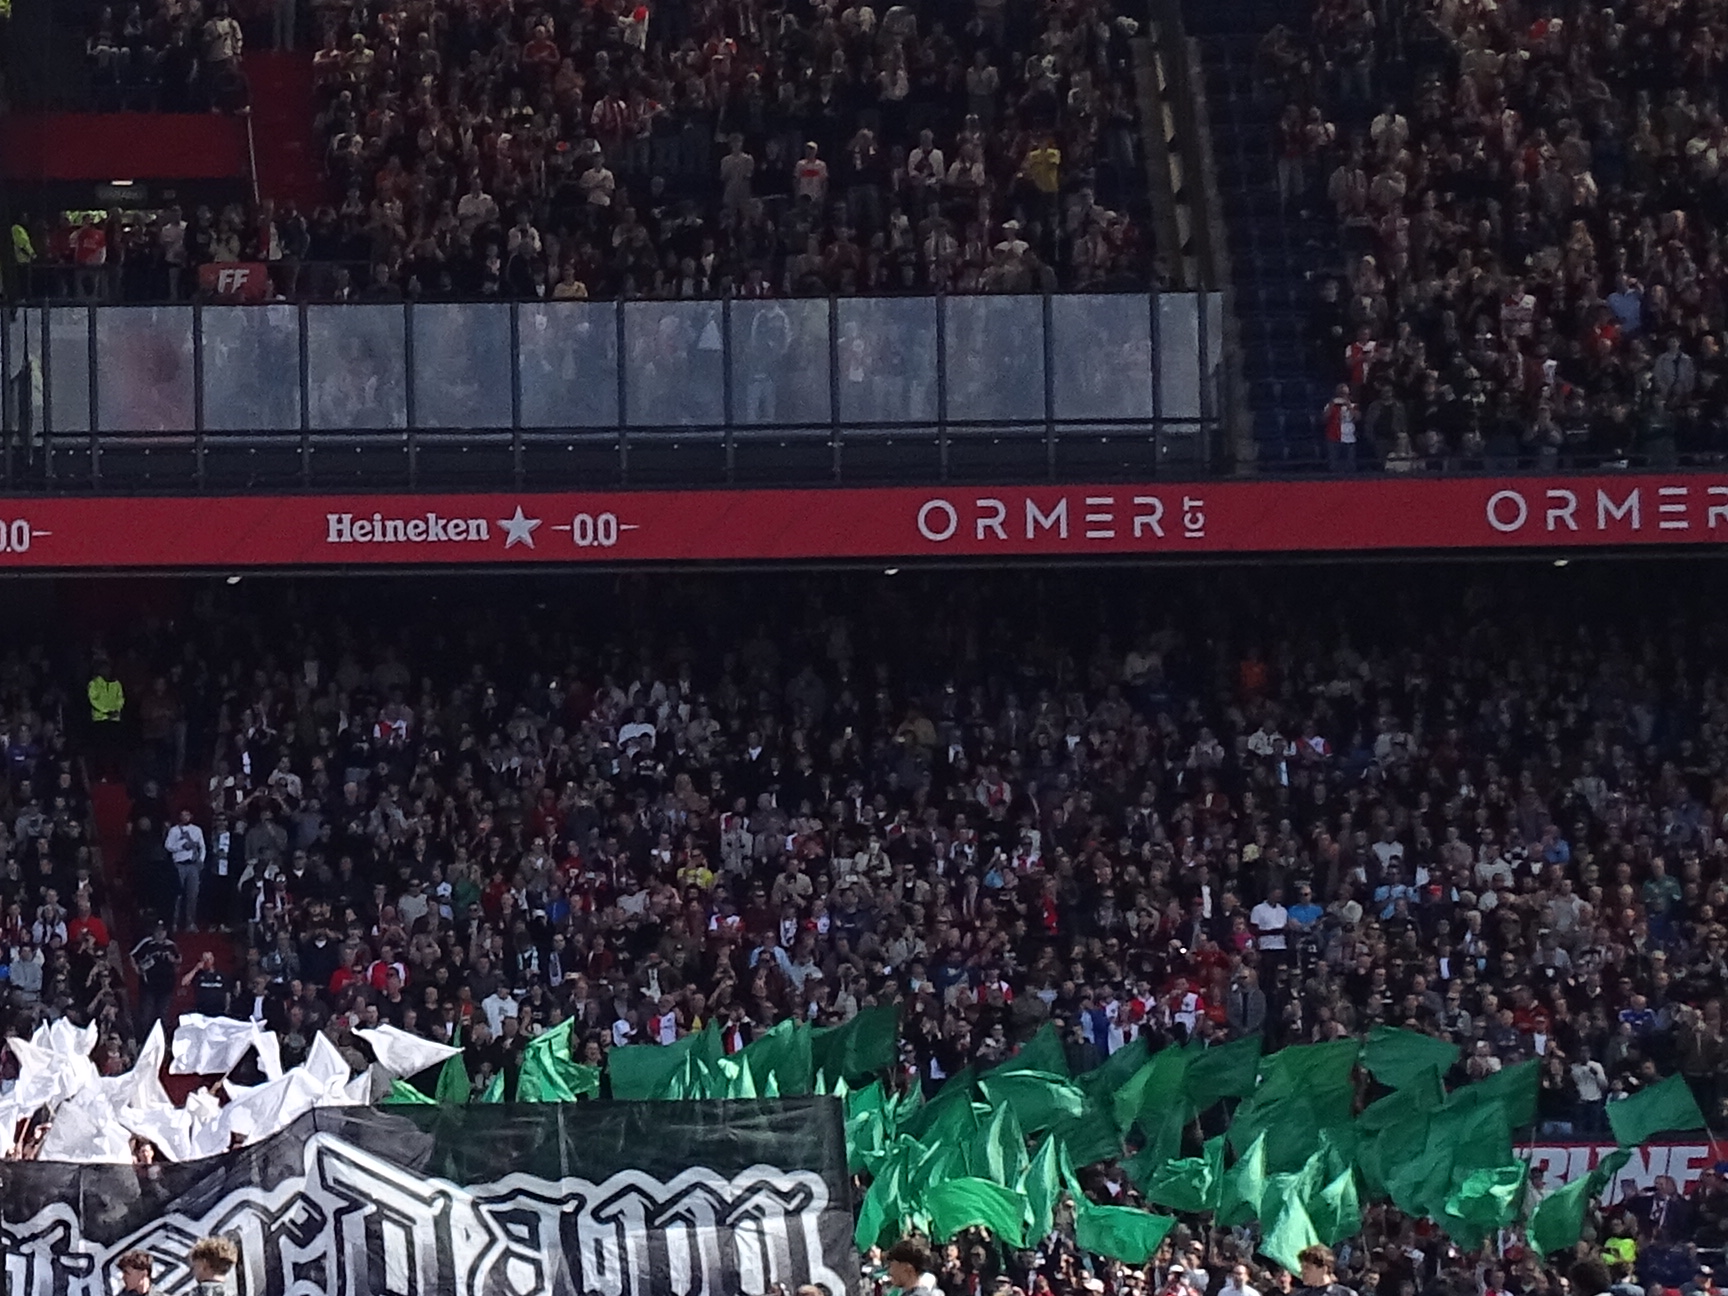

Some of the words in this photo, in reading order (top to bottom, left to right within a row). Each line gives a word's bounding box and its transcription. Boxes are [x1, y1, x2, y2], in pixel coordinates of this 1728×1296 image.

[326, 512, 490, 543] Heineken
[916, 496, 1165, 541] ORMER
[1183, 495, 1205, 538] ICT
